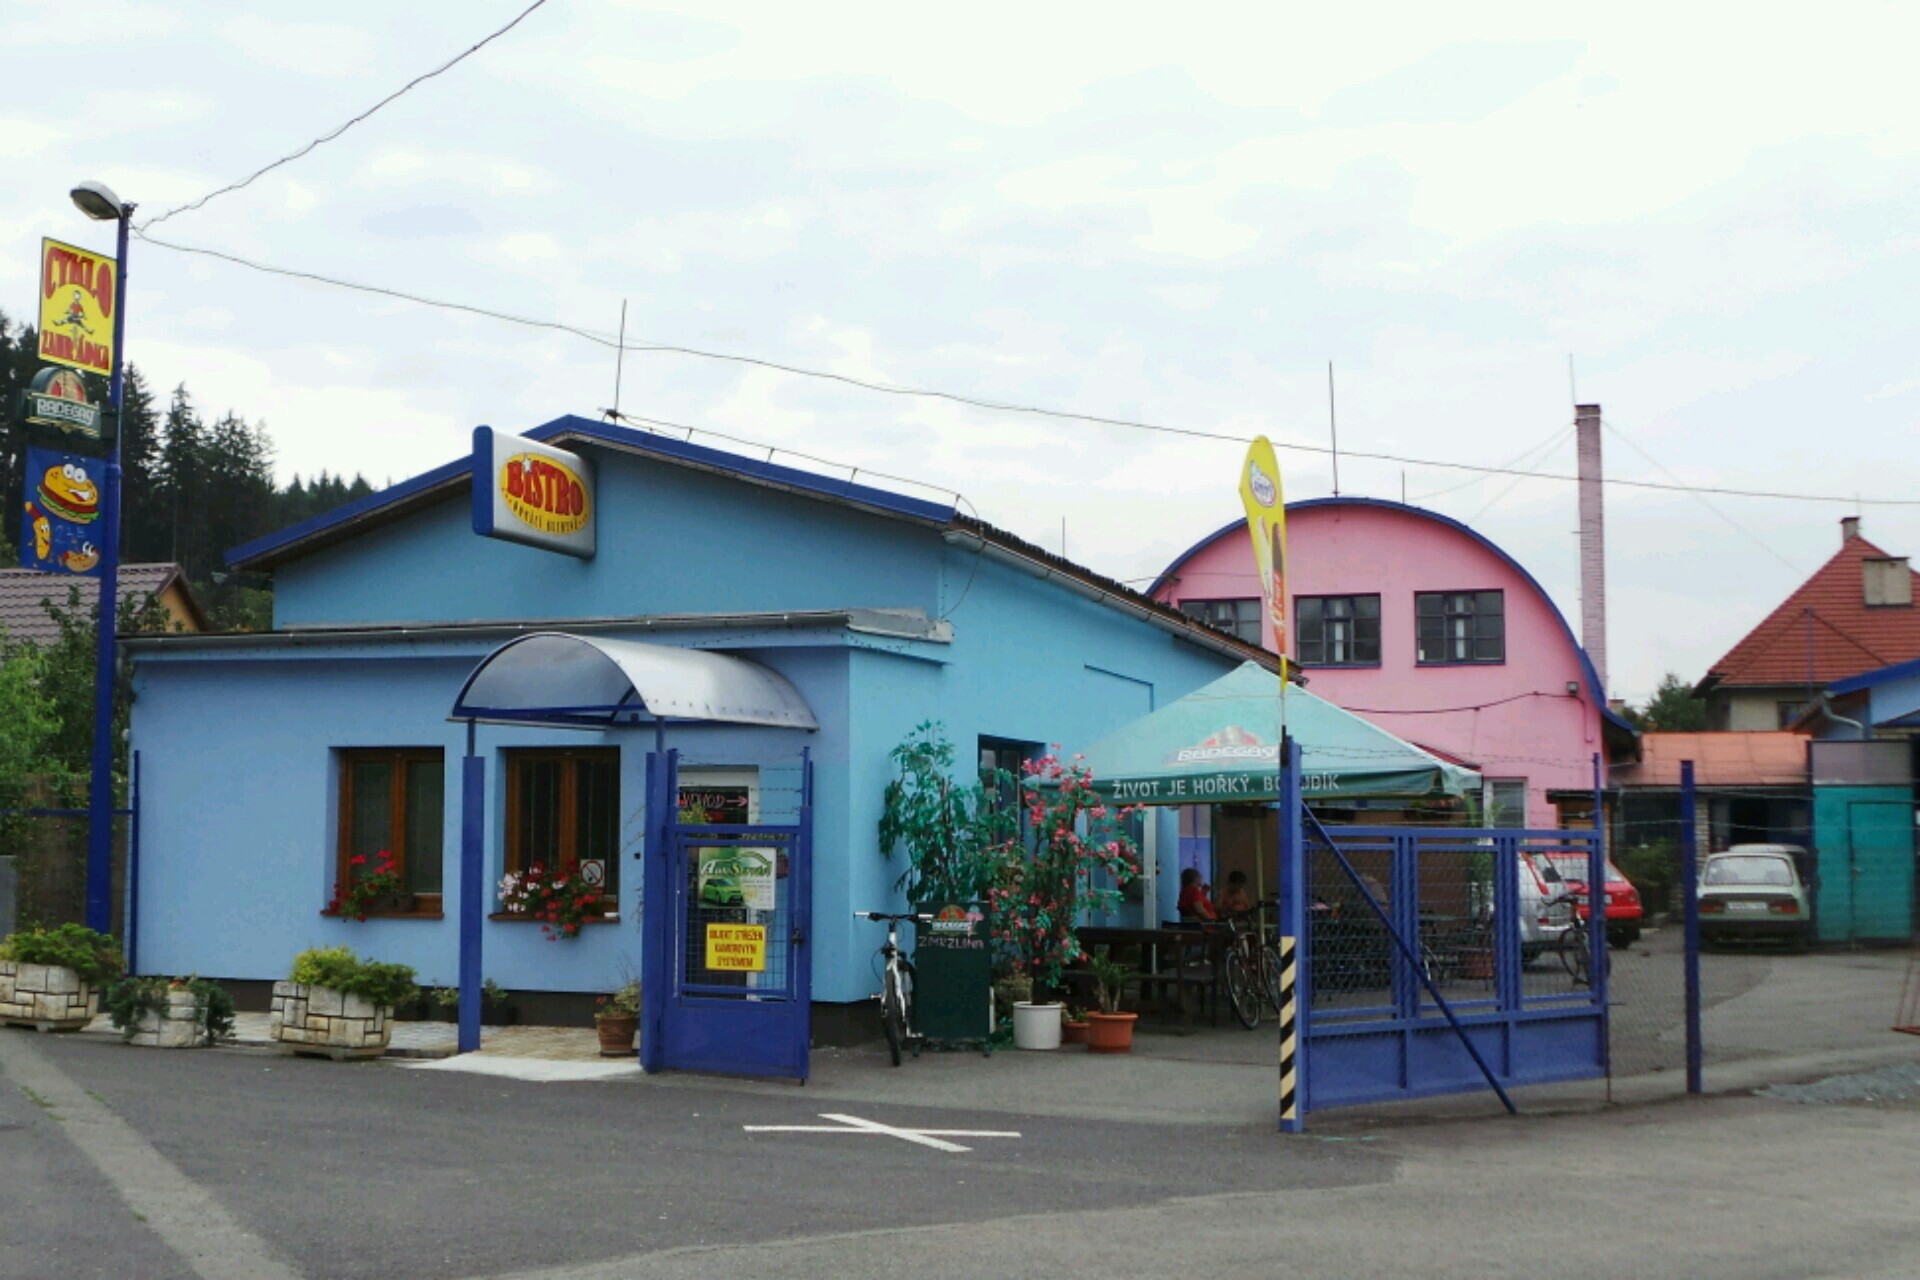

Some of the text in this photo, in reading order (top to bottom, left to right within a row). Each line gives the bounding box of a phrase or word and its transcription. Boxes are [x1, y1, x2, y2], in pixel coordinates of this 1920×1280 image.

[45, 246, 112, 318] CYKLO
[507, 459, 583, 516] BISTRO
[1112, 779, 1160, 799] ŽIVOT
[1167, 780, 1186, 796] JE
[709, 930, 733, 939] OBJEKT
